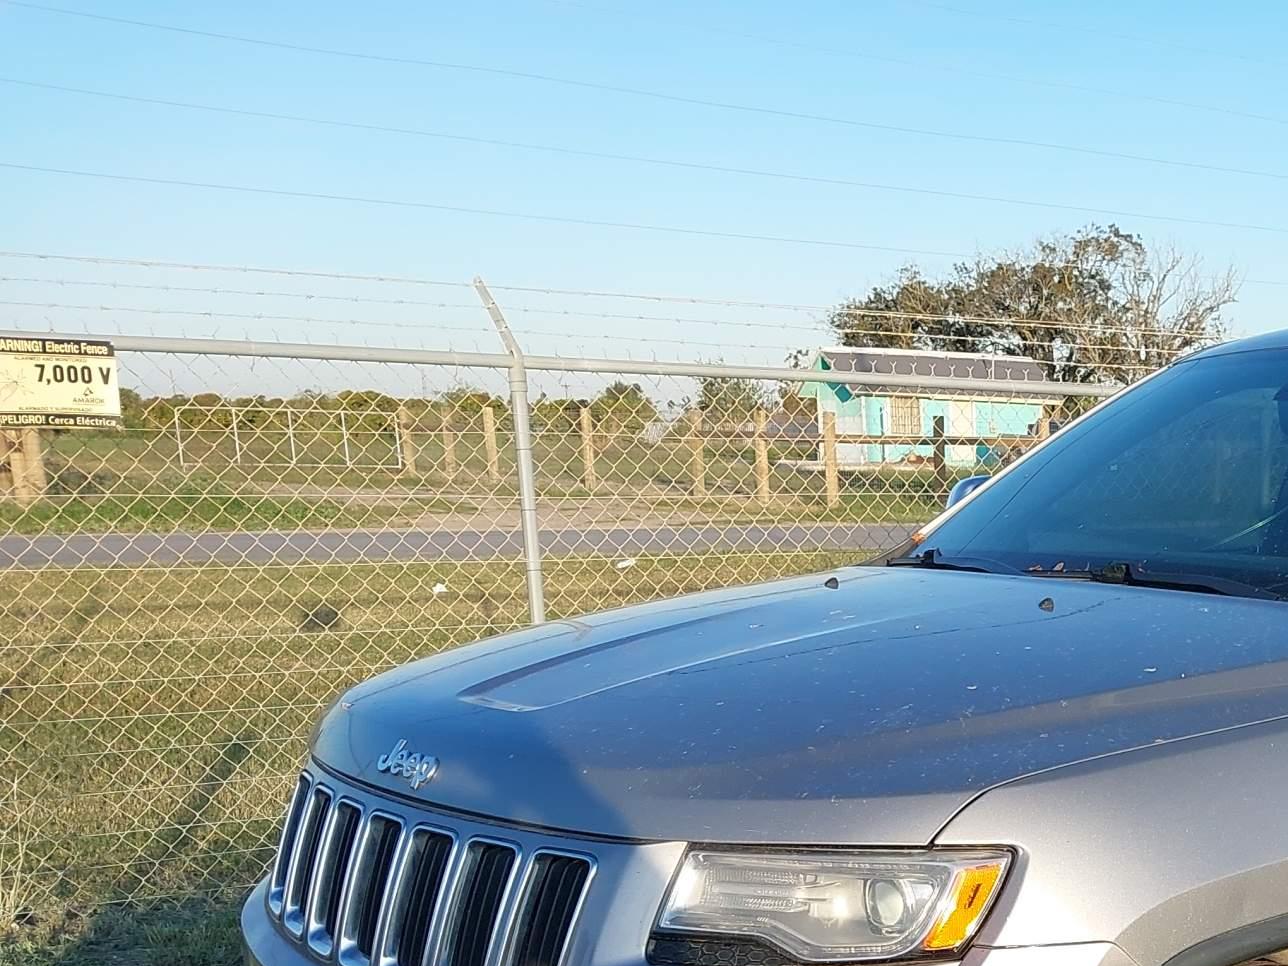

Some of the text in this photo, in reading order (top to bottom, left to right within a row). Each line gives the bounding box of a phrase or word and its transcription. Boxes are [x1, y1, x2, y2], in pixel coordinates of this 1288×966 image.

[0, 339, 108, 355] ARNING! Electric Fence
[34, 364, 111, 385] 7,000 V
[48, 415, 75, 425] Cerca
[76, 416, 116, 427] Eléctrica
[377, 738, 440, 790] Jeep
